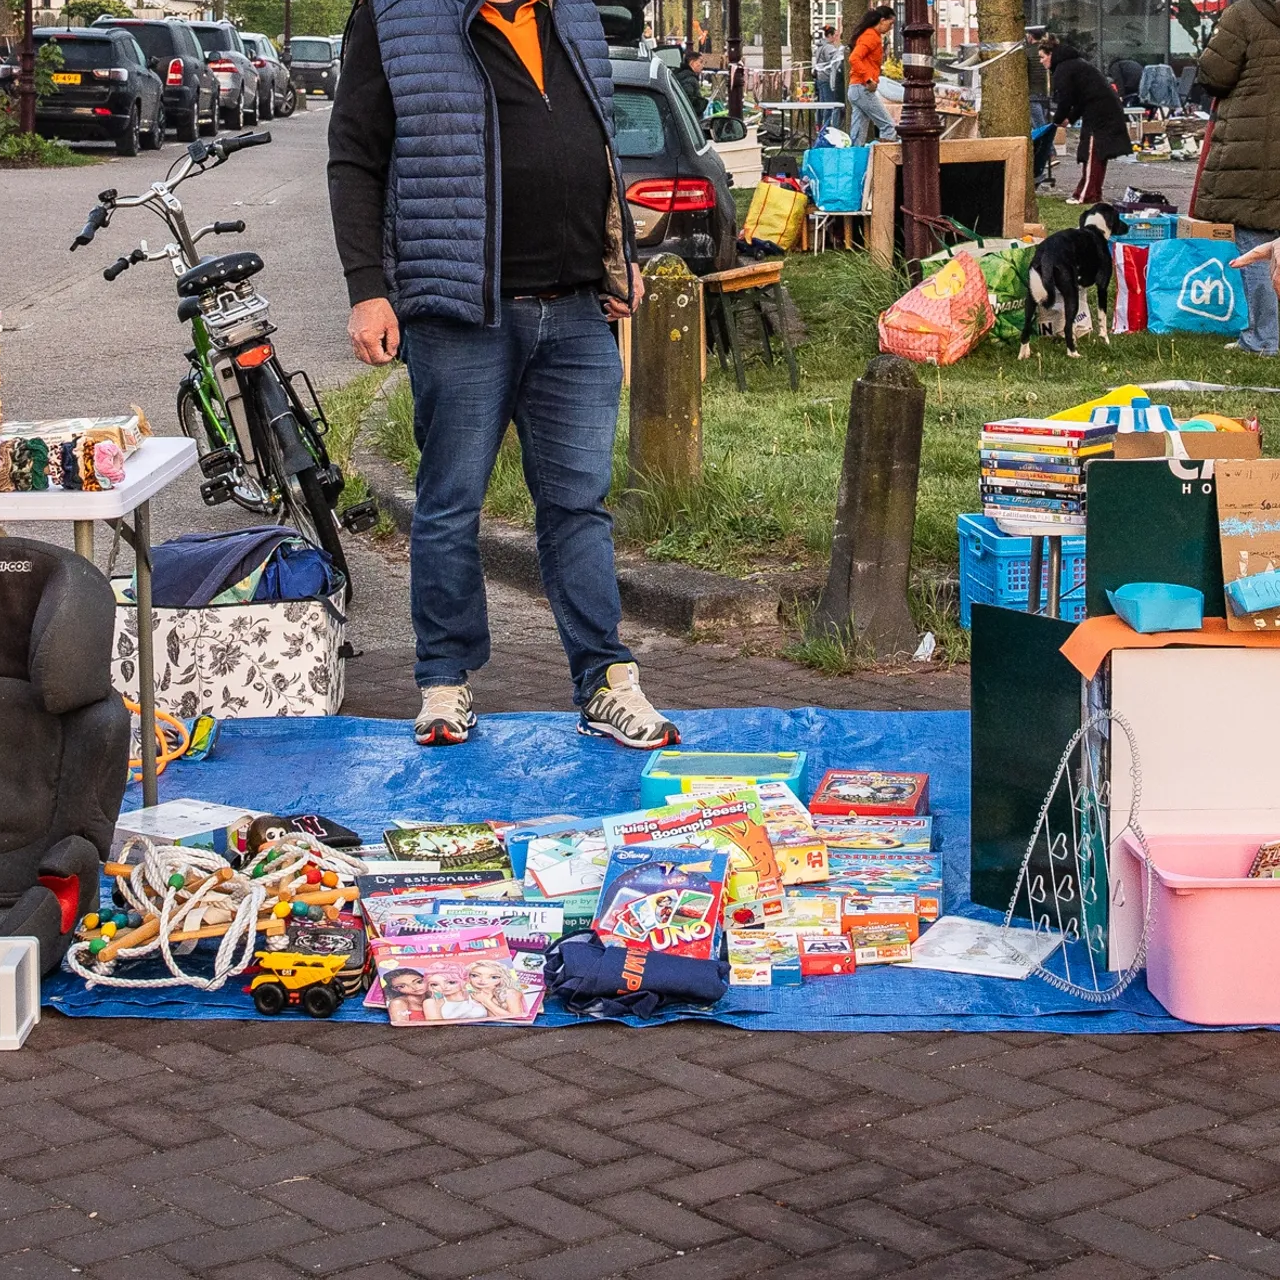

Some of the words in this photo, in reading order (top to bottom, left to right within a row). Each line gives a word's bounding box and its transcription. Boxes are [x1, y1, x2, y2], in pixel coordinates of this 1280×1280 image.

[702, 801, 757, 820] Beestje
[292, 815, 327, 838] N
[614, 821, 658, 836] Huisje
[651, 818, 714, 841] Boompje
[616, 850, 651, 861] Disney
[375, 875, 396, 885] De
[404, 873, 483, 884] astronaut
[650, 921, 711, 951] UNO
[377, 942, 456, 956] BEAUTY
[461, 937, 498, 951] FUN
